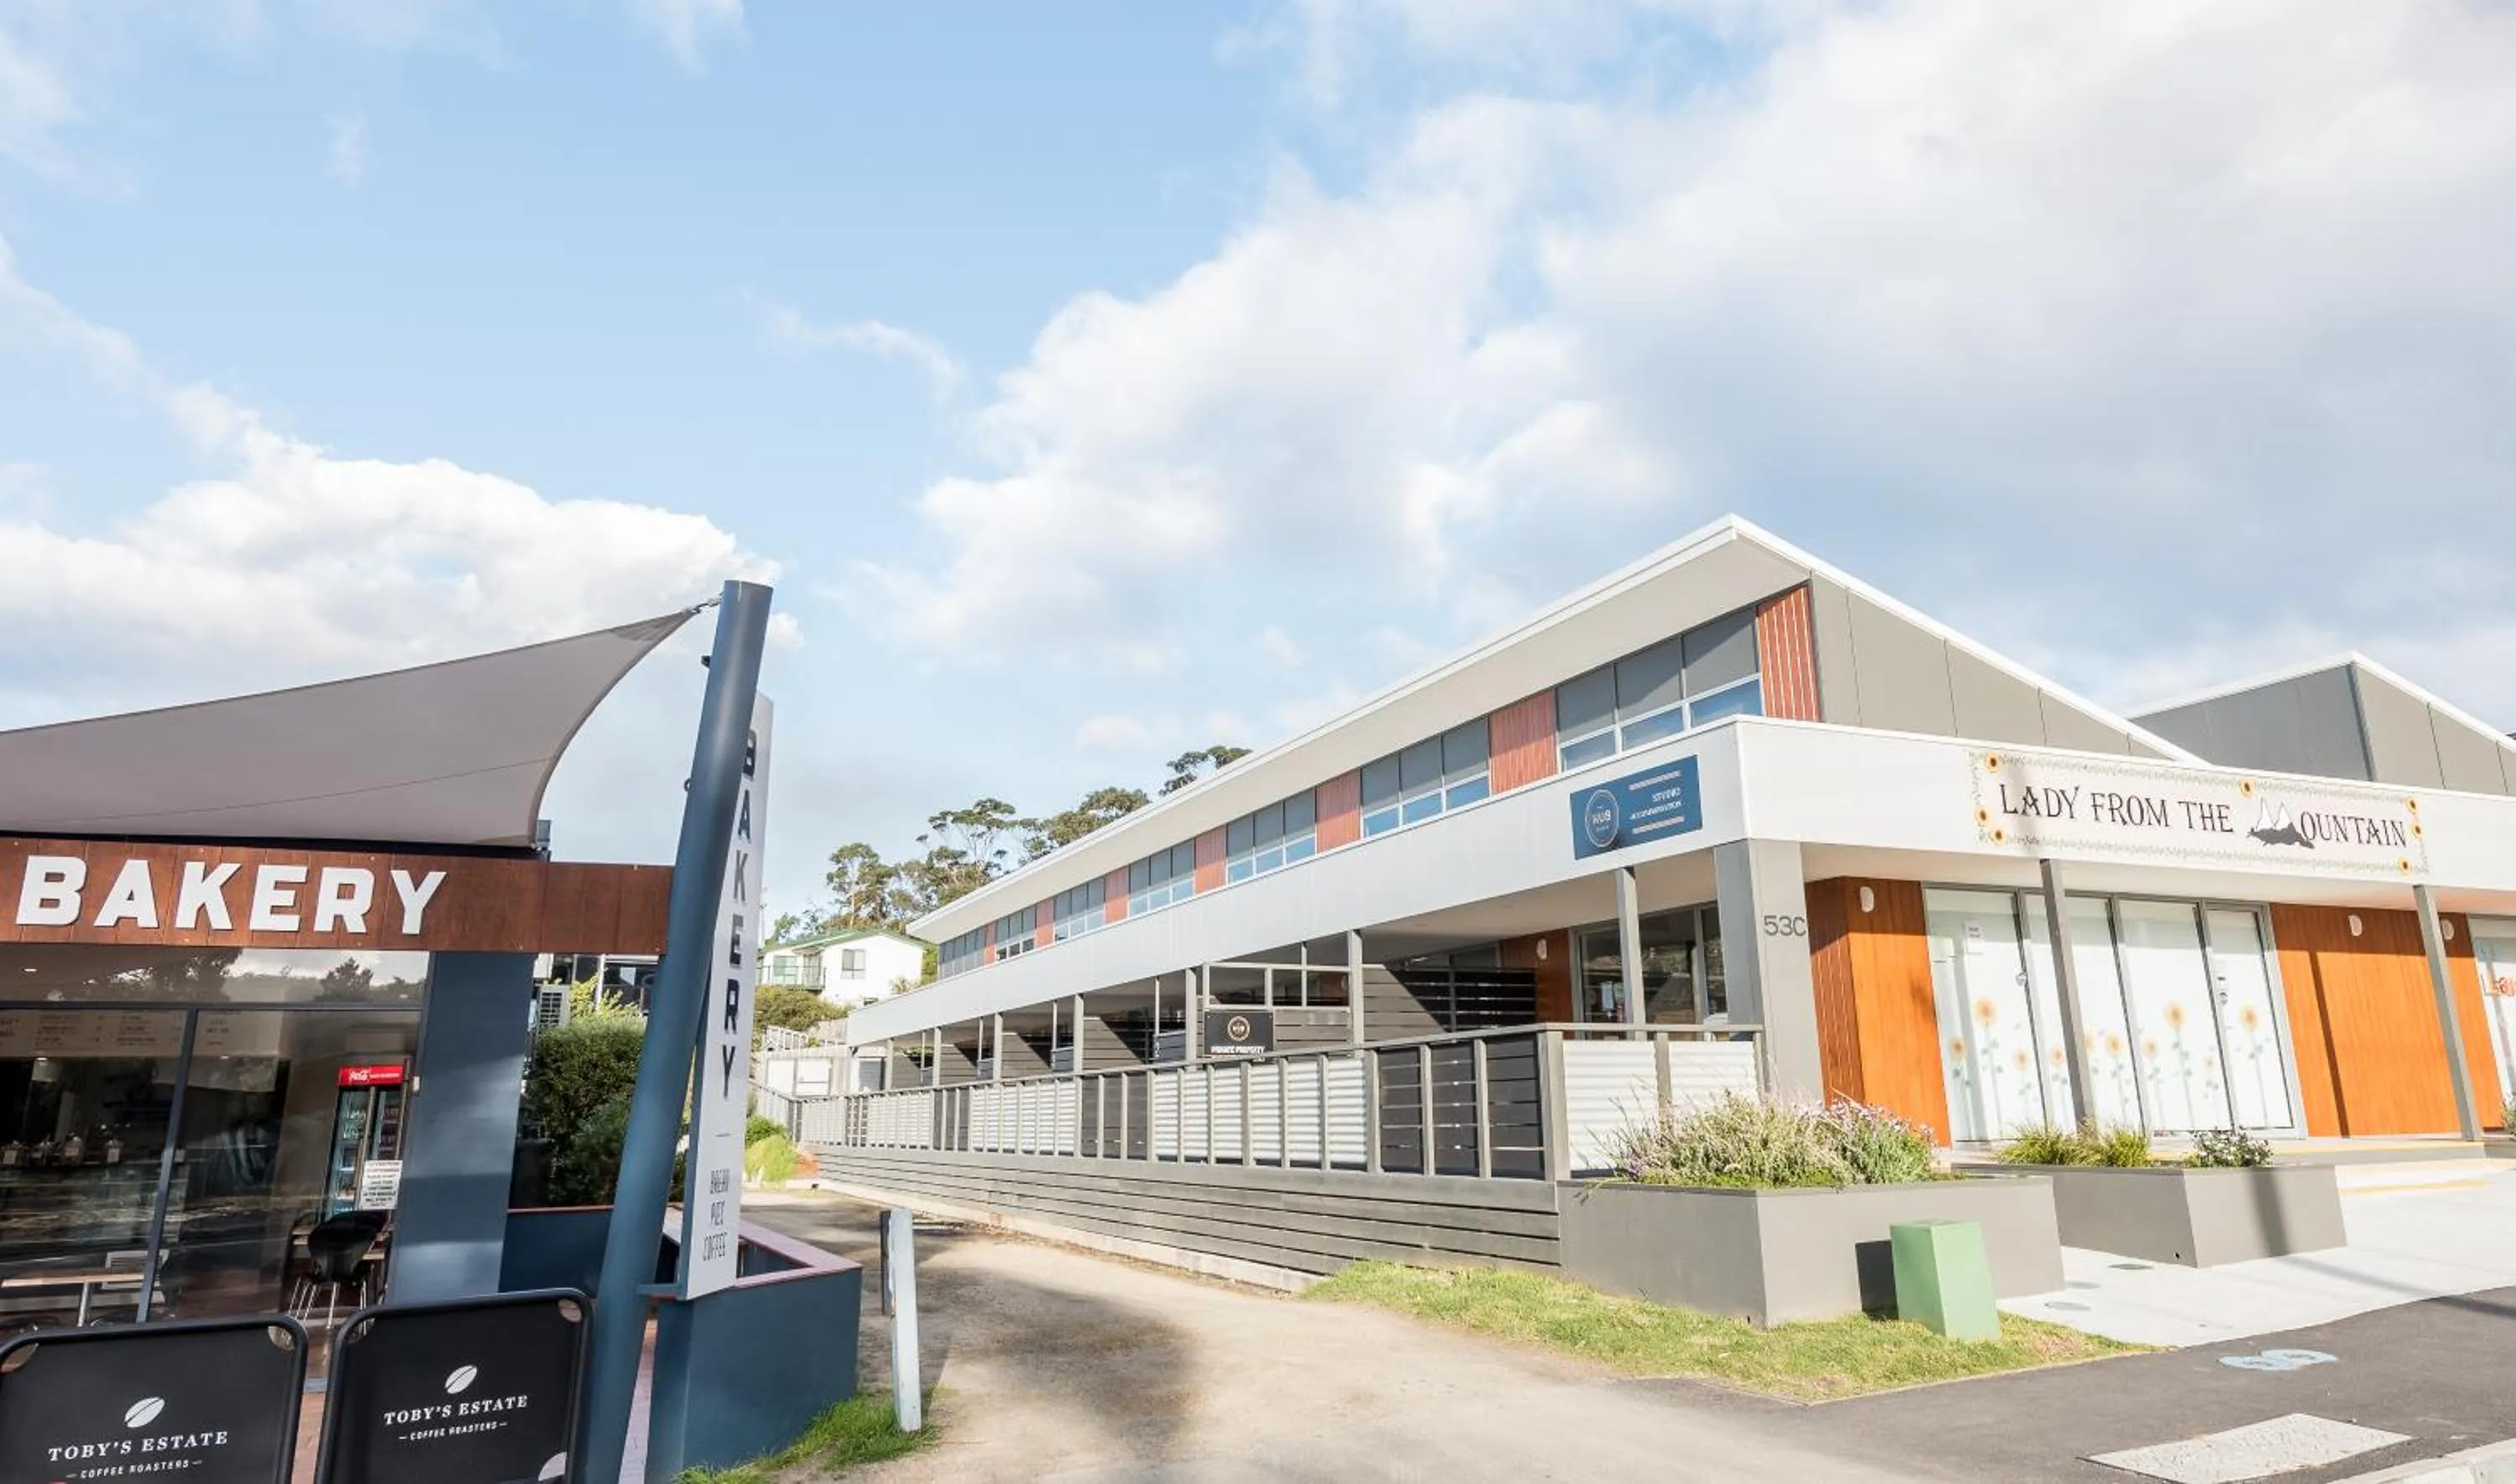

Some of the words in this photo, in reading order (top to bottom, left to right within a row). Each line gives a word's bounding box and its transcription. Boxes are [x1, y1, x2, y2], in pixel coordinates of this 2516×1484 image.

[1999, 784, 2080, 819] LADY
[2090, 792, 2170, 828] FROM
[2178, 801, 2234, 833] THE
[15, 855, 447, 935] BAKERY
[723, 729, 757, 1097] BAKERY
[1764, 915, 1806, 937] 53C
[703, 1232, 727, 1262] COFFEE
[383, 1404, 452, 1426] TOBY'S
[458, 1395, 529, 1416] ESTATE
[48, 1440, 133, 1461] TOBY'S
[141, 1430, 229, 1452] ESTATE
[410, 1428, 445, 1441] COFFEE
[449, 1421, 497, 1435] ROASTERS
[80, 1466, 124, 1479] COFFEE
[128, 1459, 190, 1475] ROASTERS
